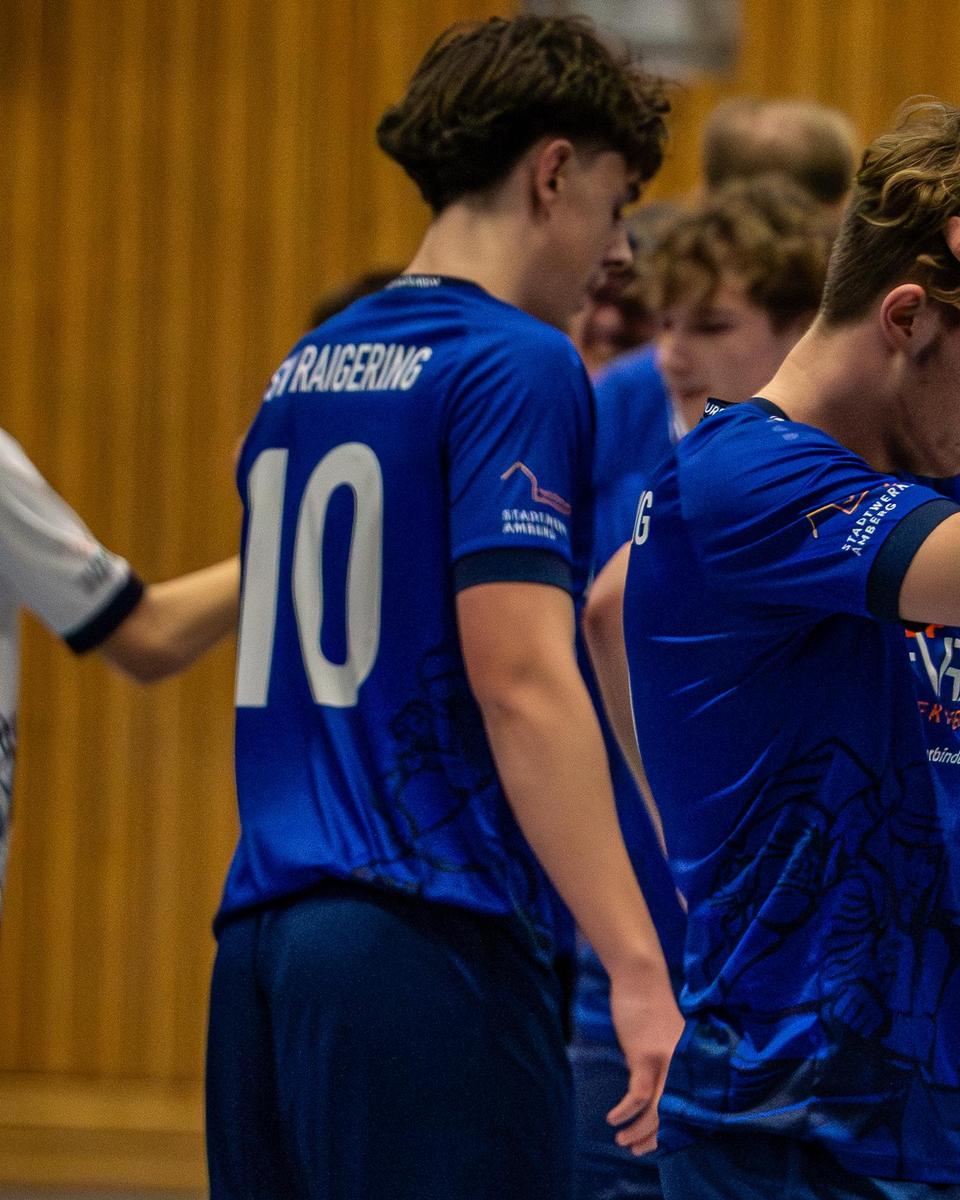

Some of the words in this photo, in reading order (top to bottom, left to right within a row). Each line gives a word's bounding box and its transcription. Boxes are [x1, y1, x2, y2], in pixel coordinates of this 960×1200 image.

[288, 343, 433, 393] RAIGERING
[841, 483, 915, 551] STADTWERK
[851, 502, 897, 557] AMBERG
[234, 441, 384, 709] 10
